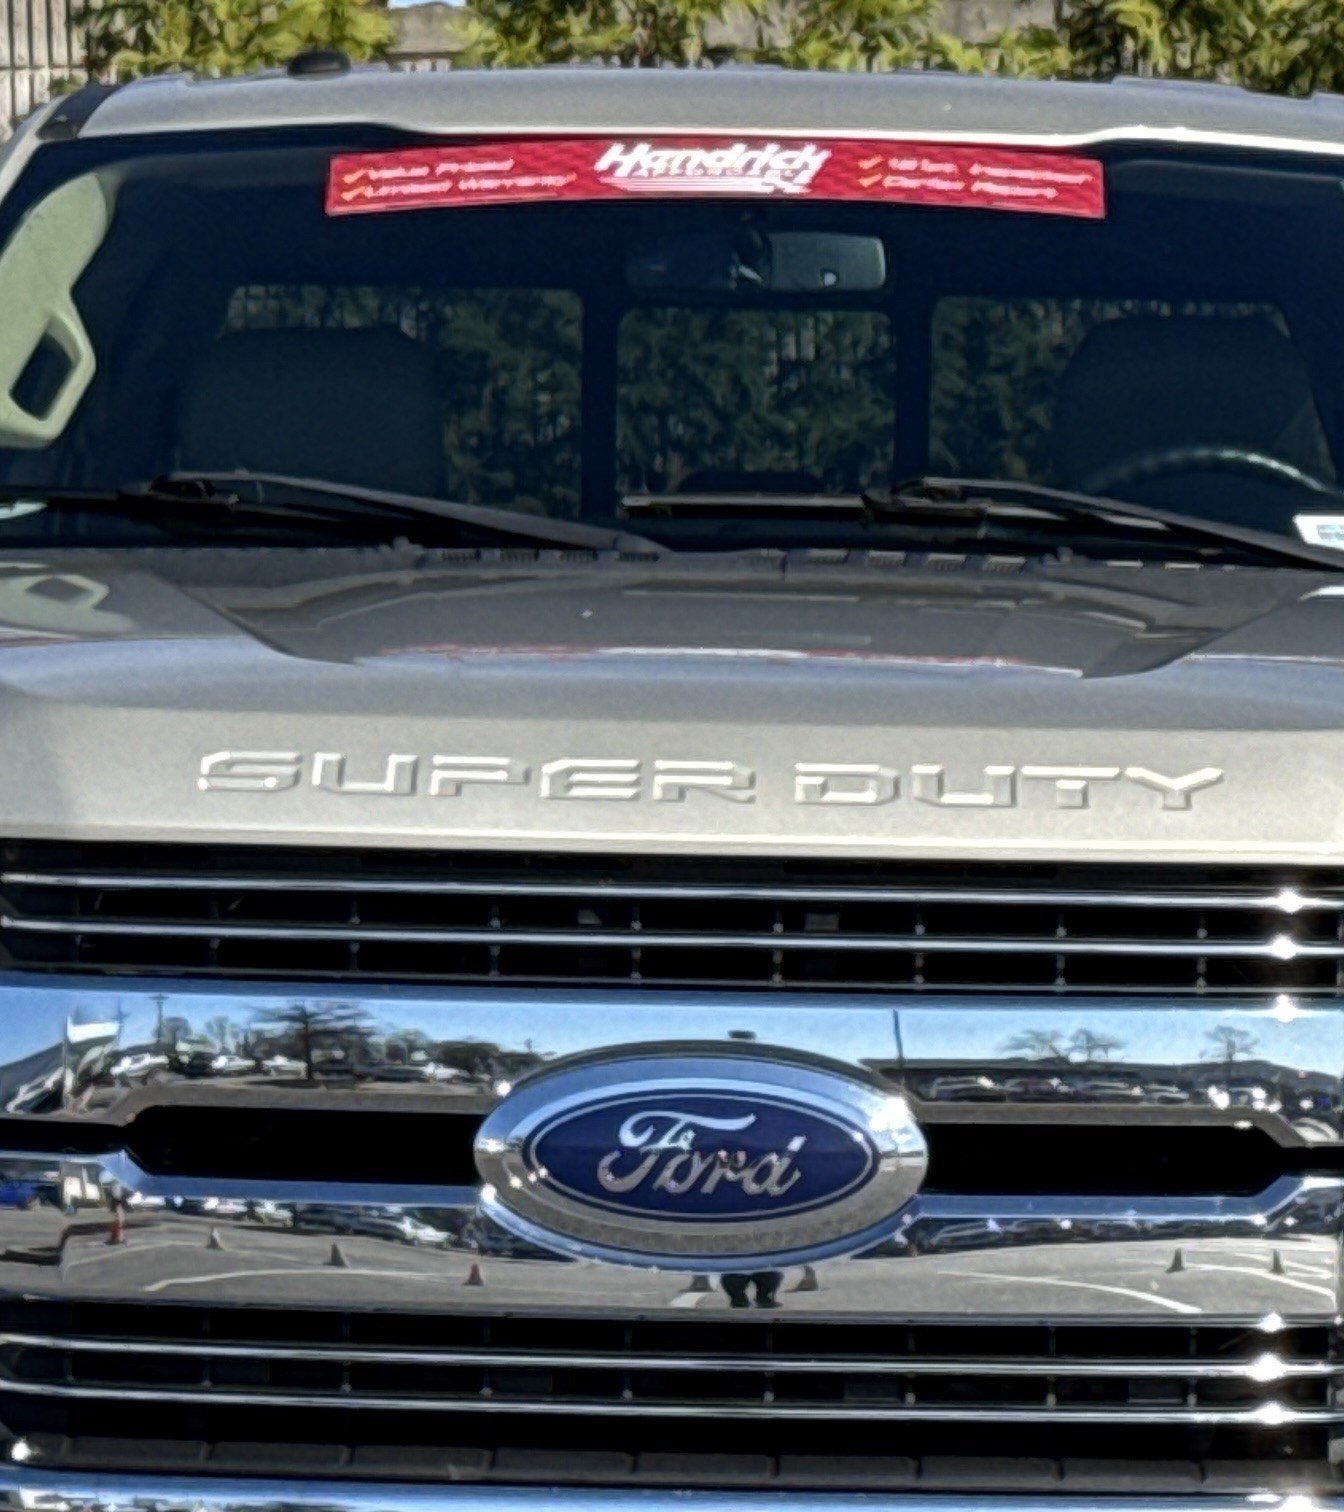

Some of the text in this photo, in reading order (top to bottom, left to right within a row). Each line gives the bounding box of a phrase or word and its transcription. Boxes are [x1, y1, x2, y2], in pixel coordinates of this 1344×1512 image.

[197, 751, 1224, 811] SUPER DUTY
[596, 1109, 808, 1198] Ford
